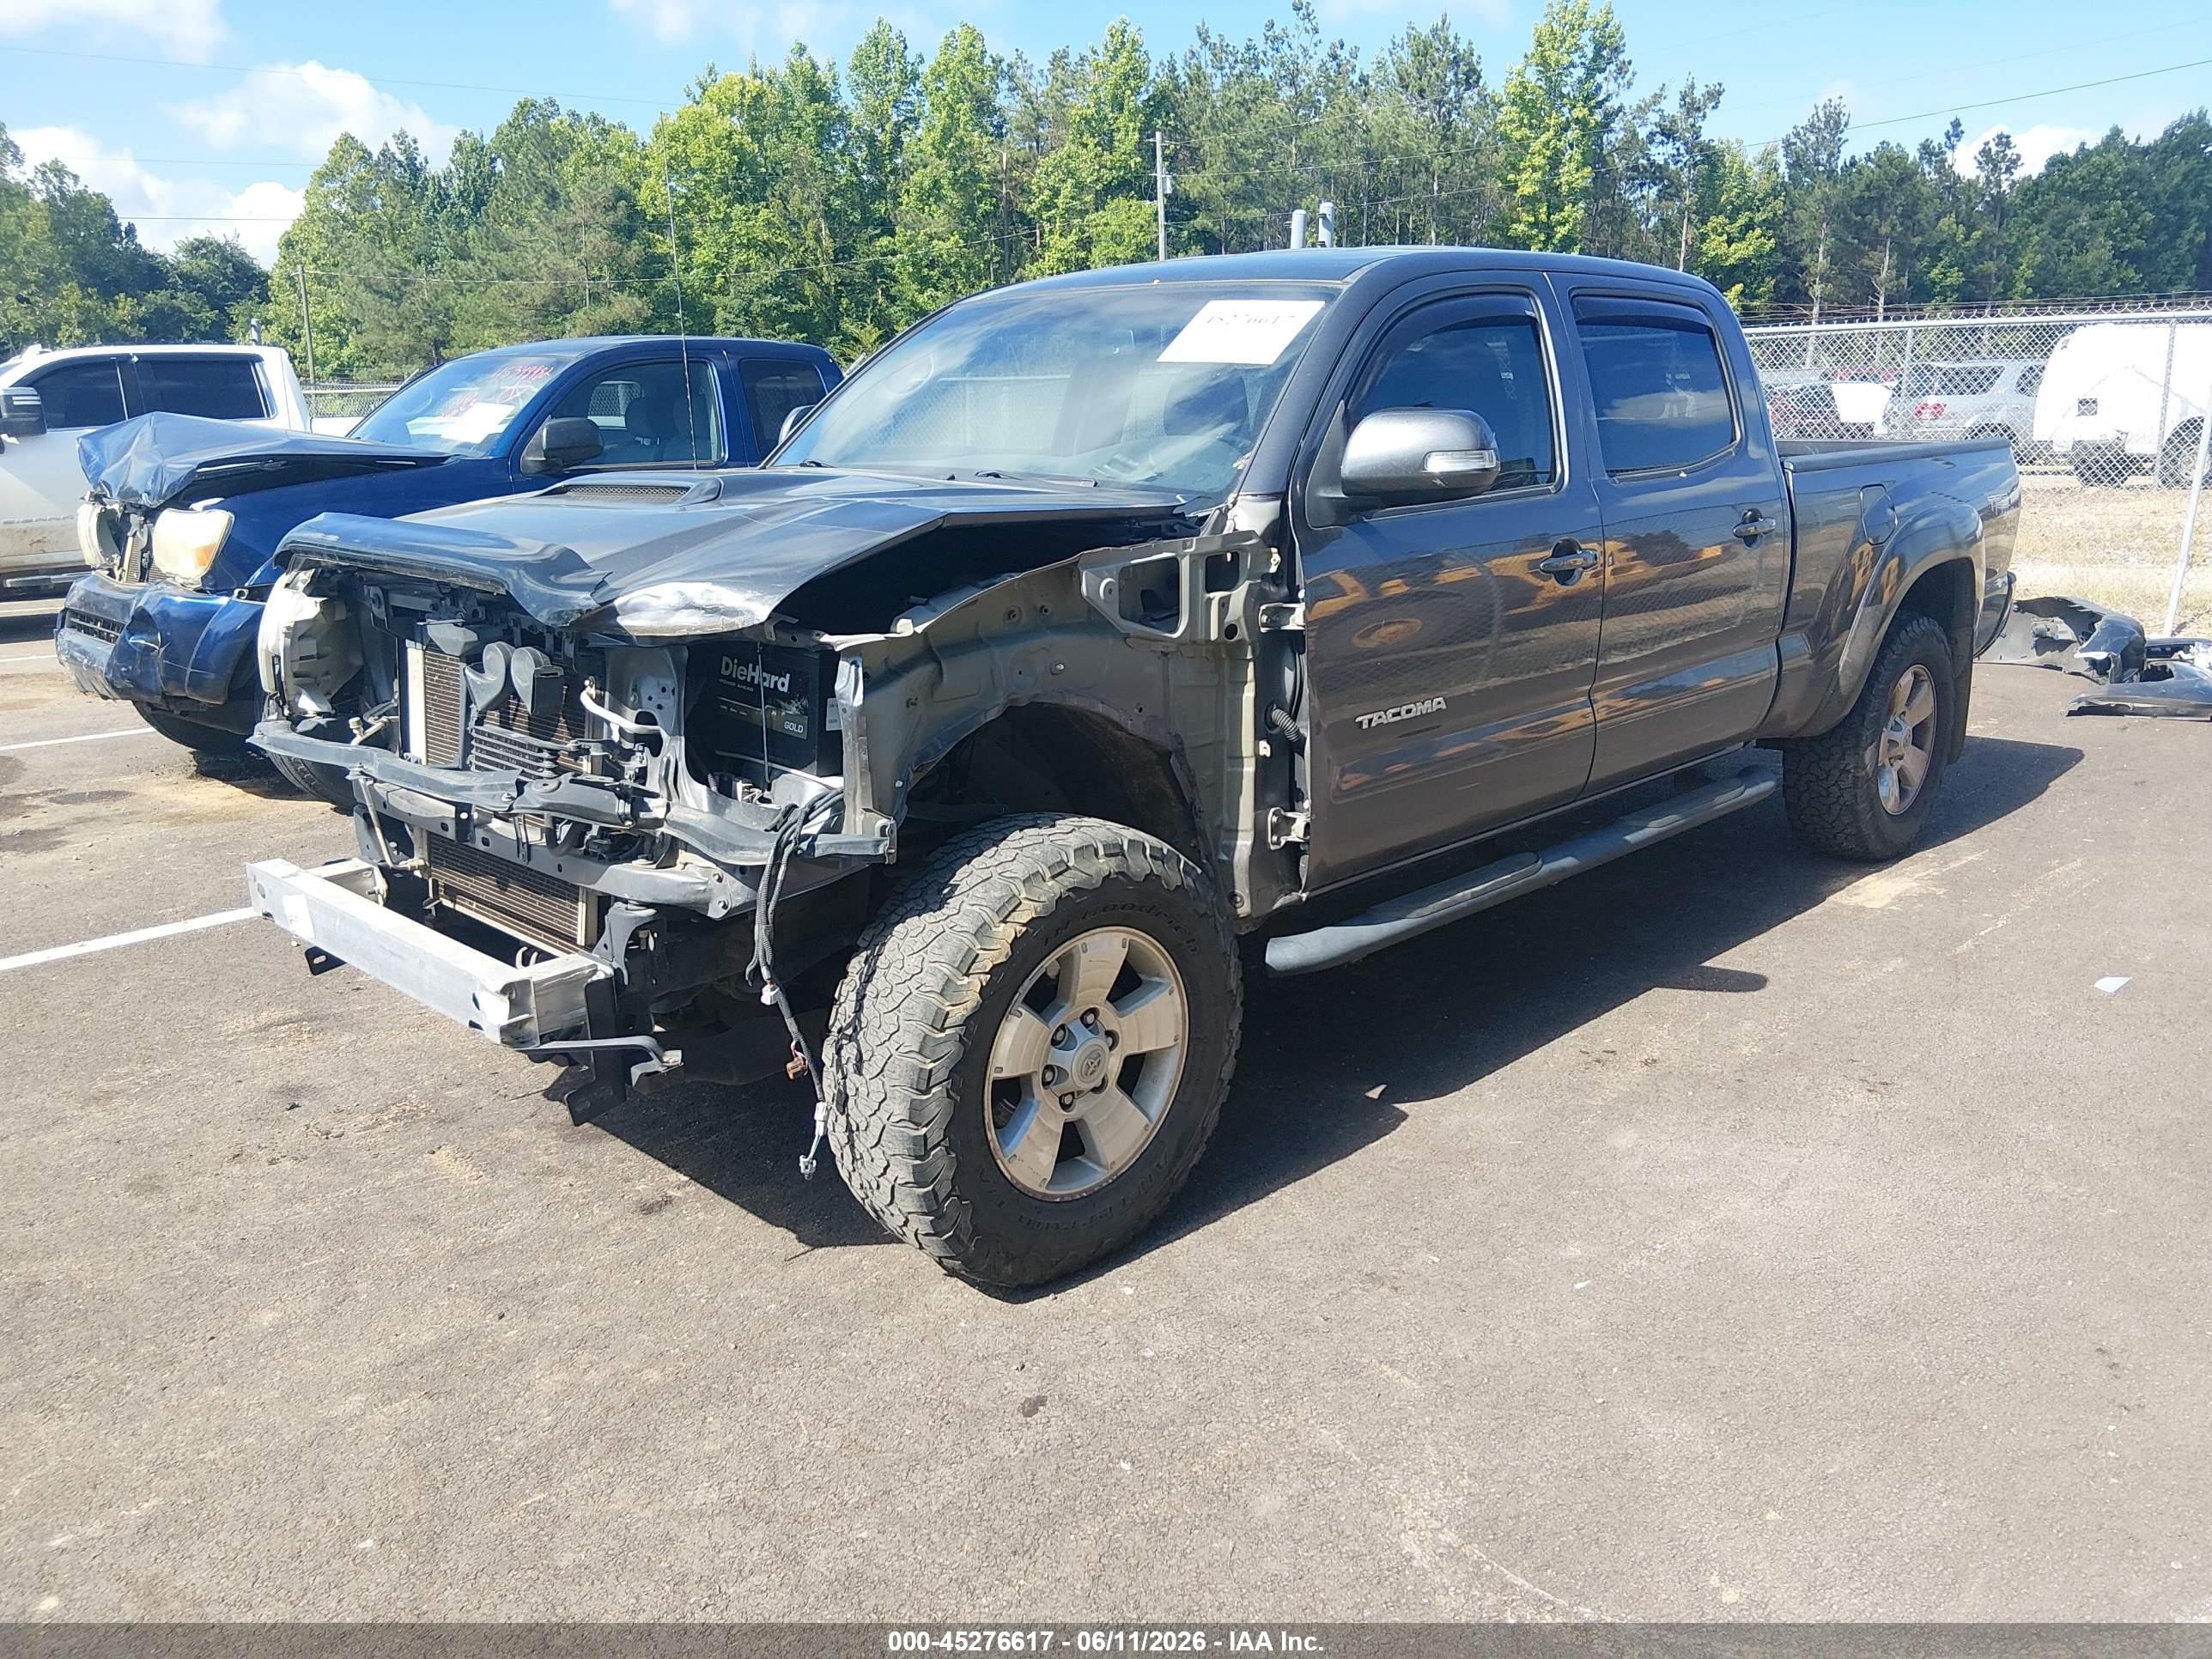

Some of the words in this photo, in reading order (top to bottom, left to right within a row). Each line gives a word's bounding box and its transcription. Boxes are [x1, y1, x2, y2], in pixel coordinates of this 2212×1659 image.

[720, 655, 790, 693] DieHard
[784, 720, 803, 733] GOLD
[1354, 696, 1447, 730] TACOMA
